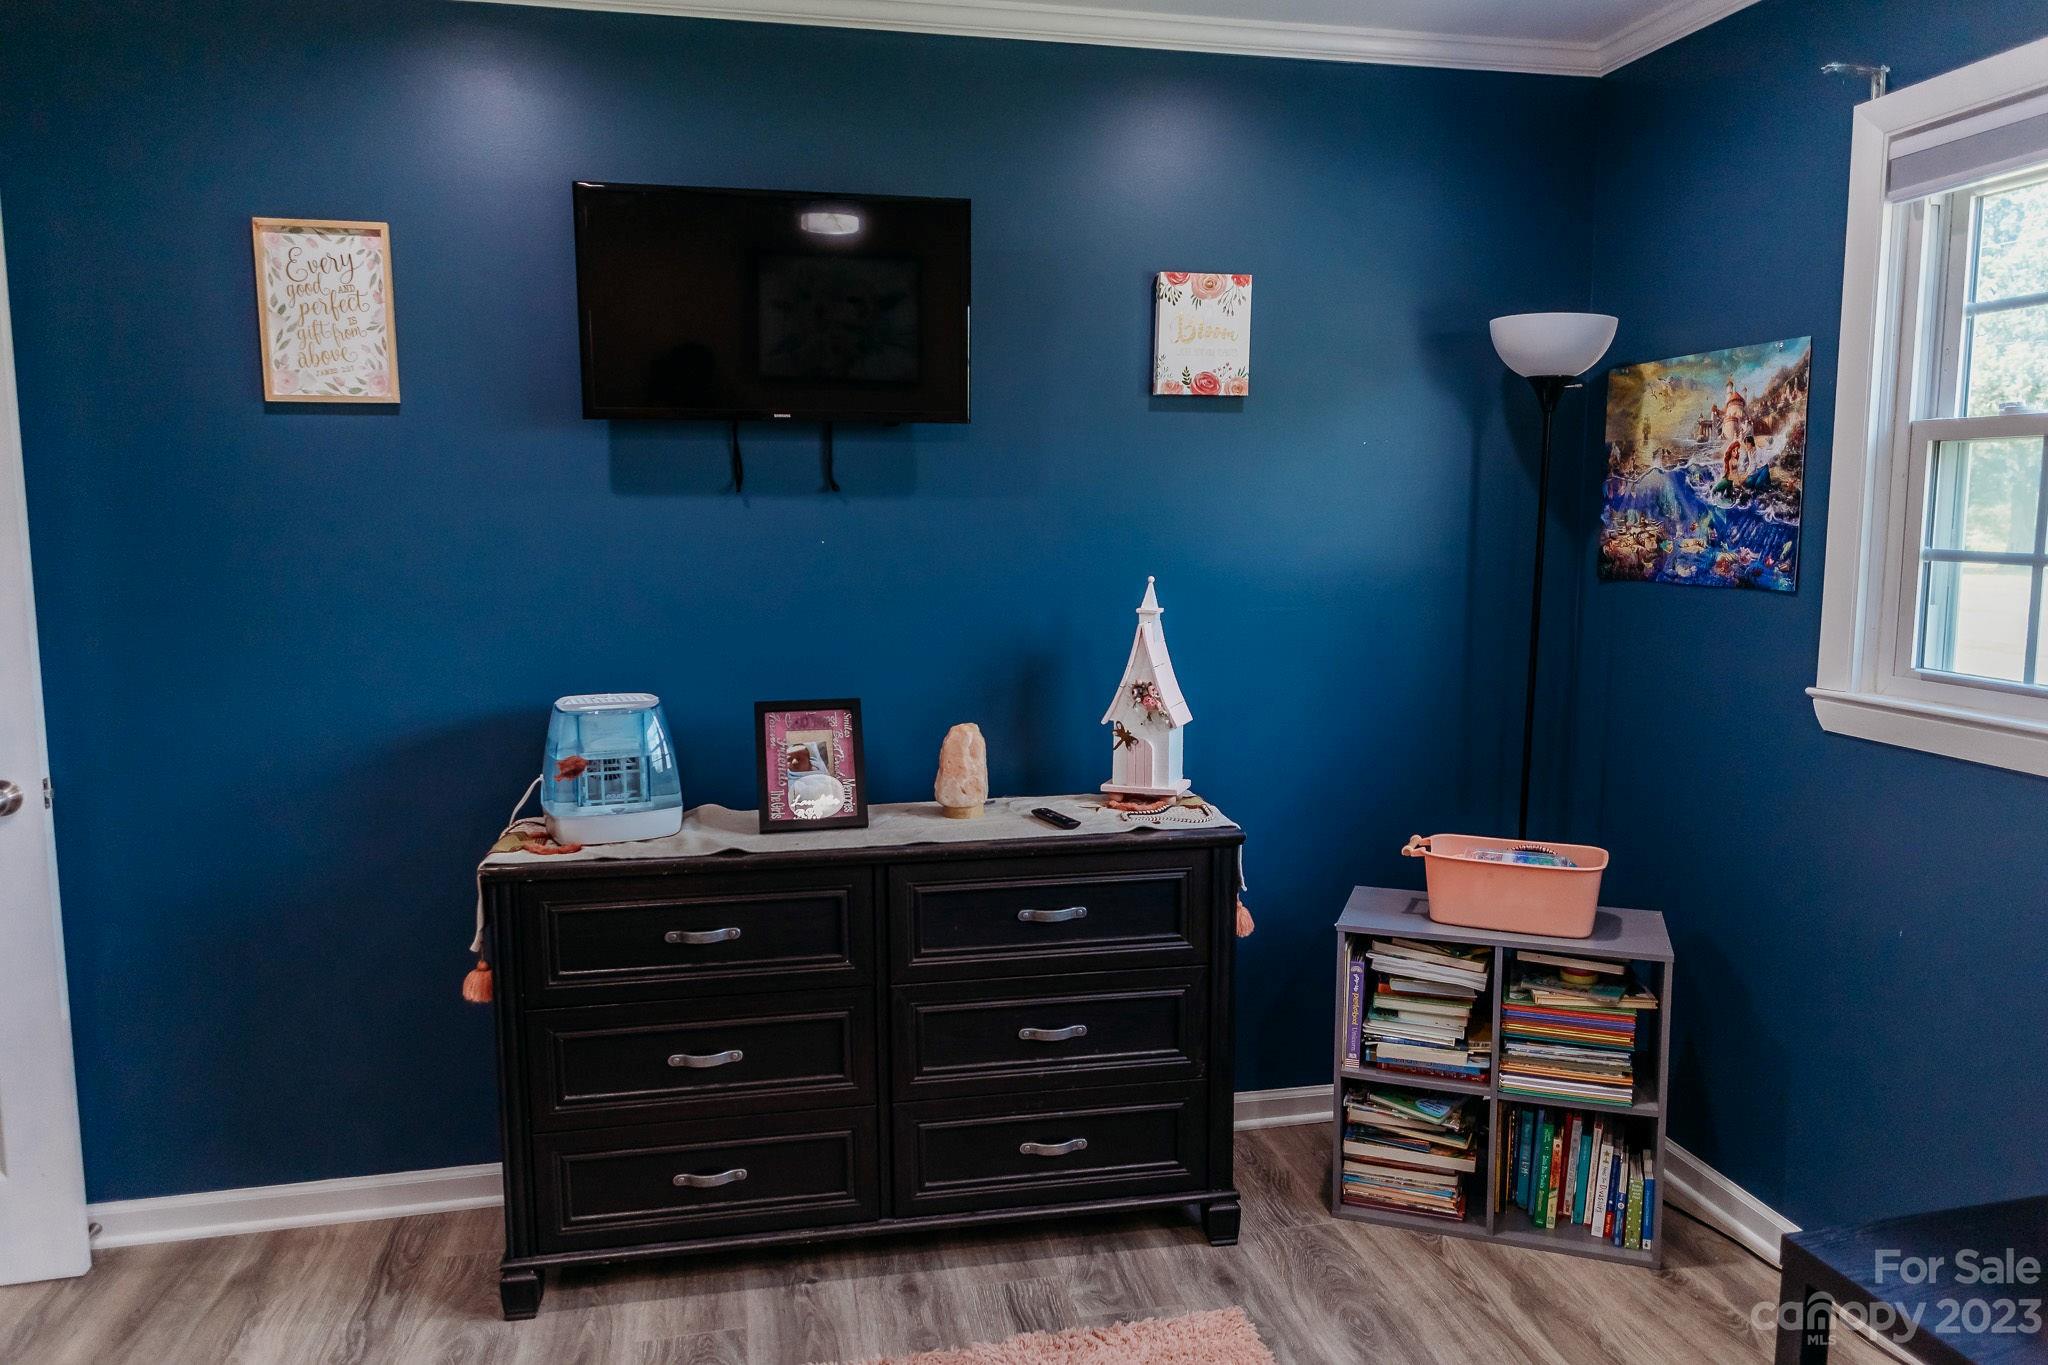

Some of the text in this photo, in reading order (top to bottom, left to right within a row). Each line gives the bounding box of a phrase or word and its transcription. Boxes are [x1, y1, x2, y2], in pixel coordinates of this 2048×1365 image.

[286, 247, 364, 284] Every
[287, 272, 356, 308] good AND
[299, 289, 370, 326] perfect
[297, 319, 332, 349] gift
[331, 323, 368, 347] from
[298, 343, 358, 369] above
